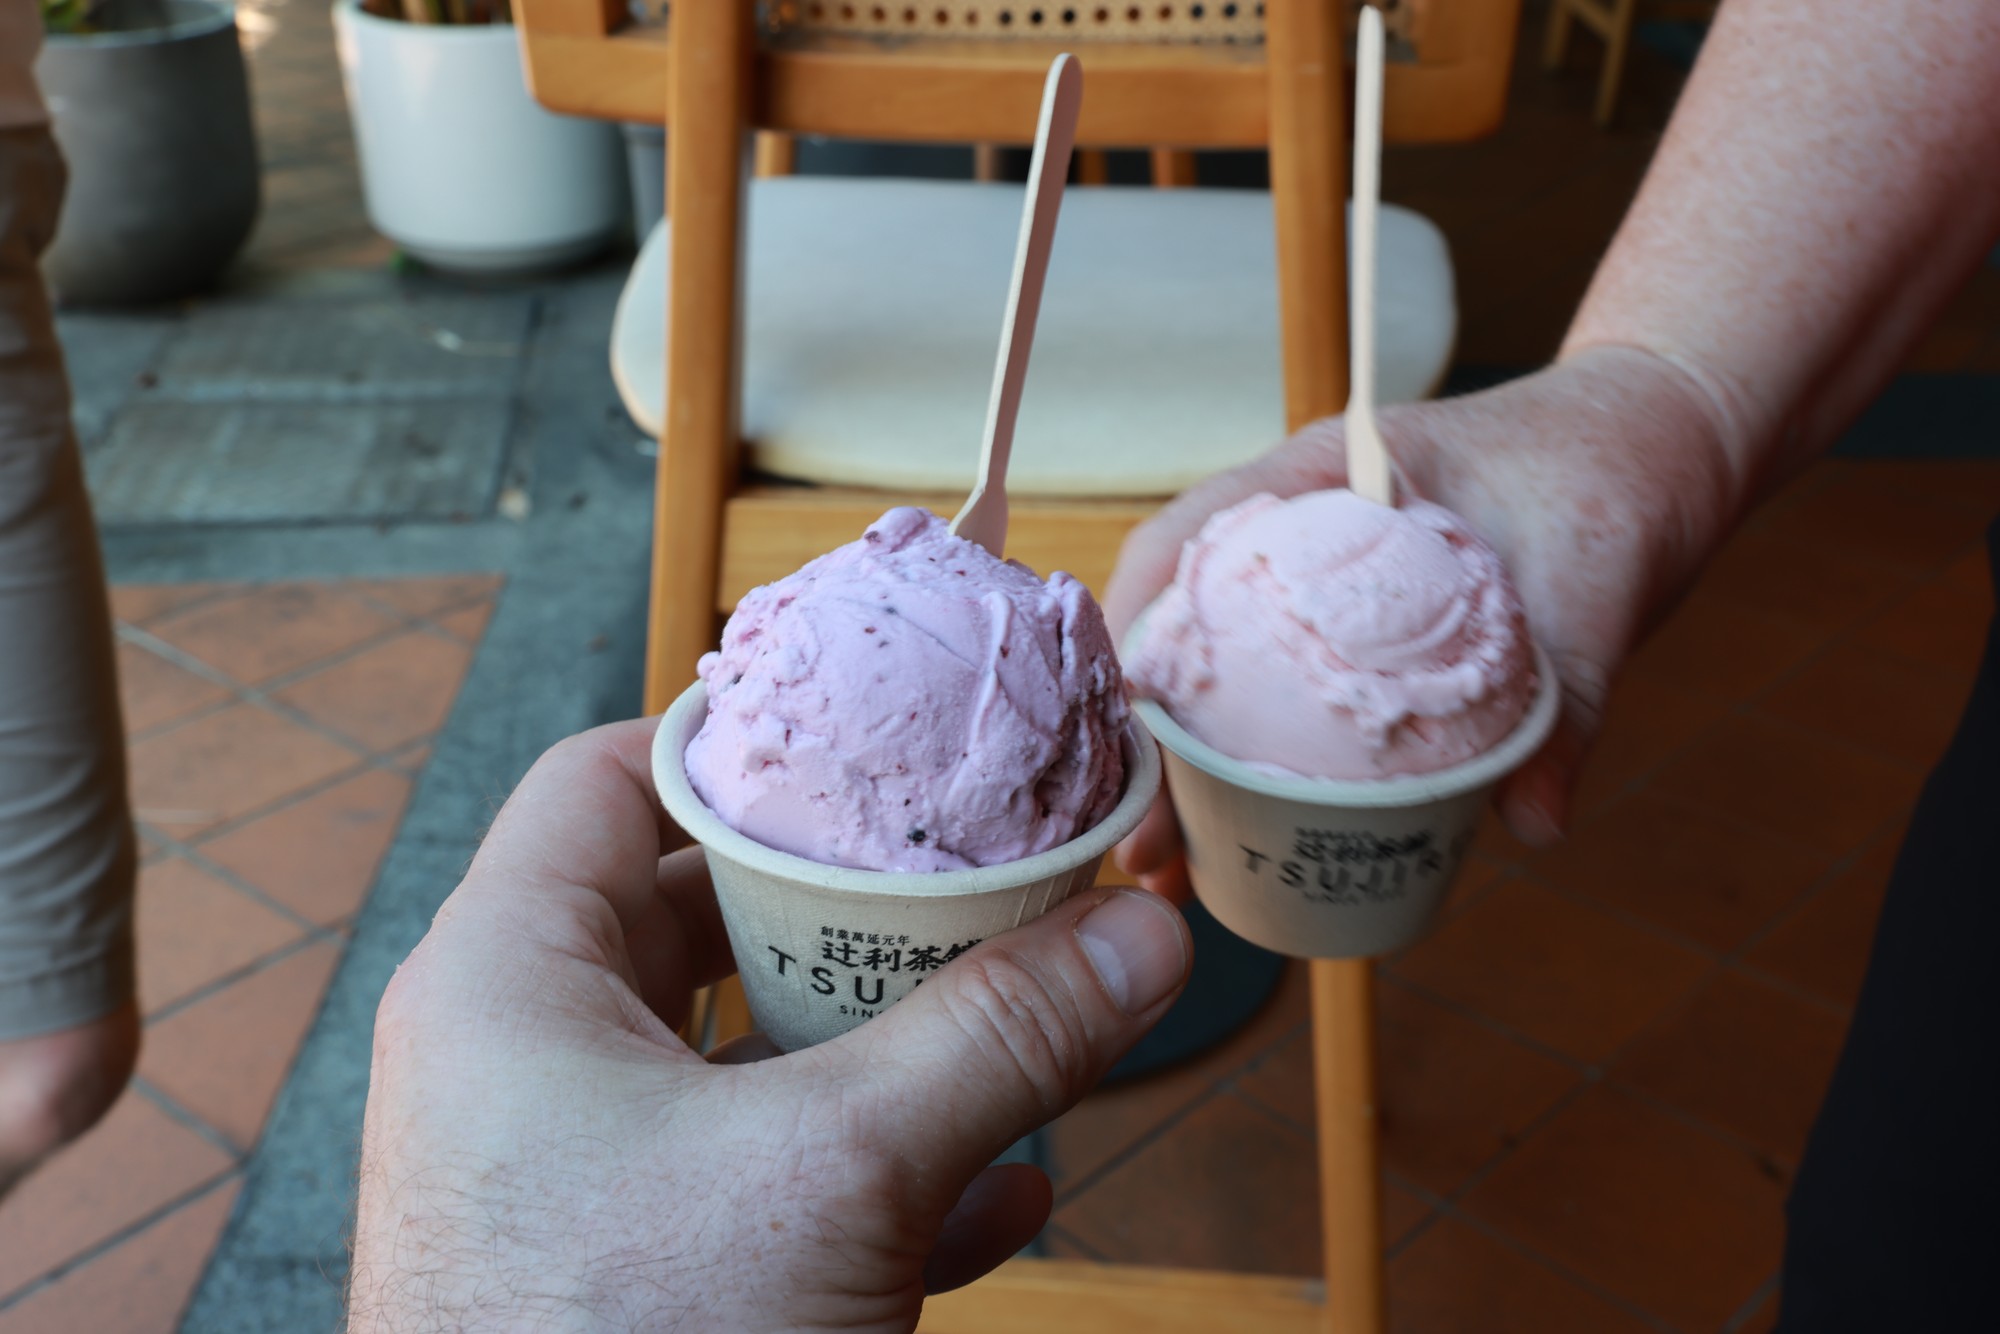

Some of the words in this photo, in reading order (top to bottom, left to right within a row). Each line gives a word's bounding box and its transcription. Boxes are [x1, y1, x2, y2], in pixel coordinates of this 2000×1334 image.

[820, 925, 910, 946] 創業萬延元年
[767, 946, 925, 1005] TSU
[839, 1005, 883, 1019] SIN
